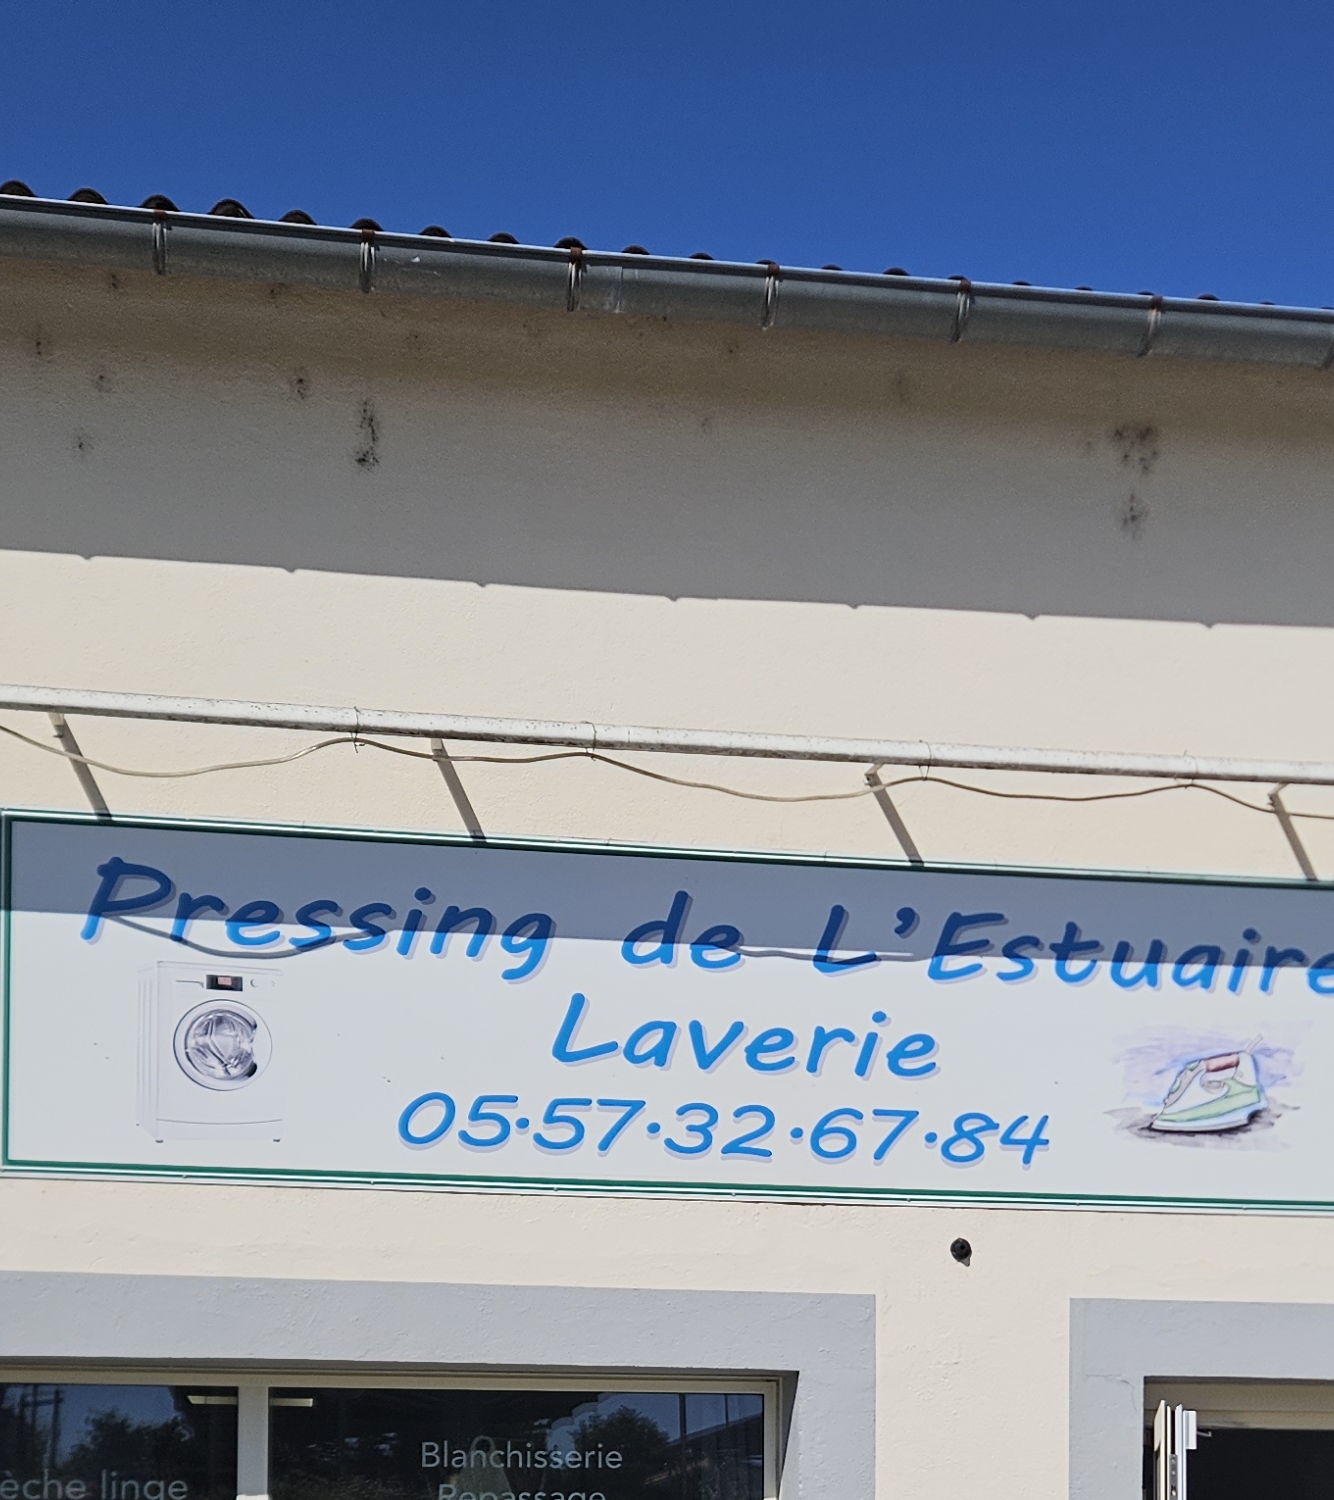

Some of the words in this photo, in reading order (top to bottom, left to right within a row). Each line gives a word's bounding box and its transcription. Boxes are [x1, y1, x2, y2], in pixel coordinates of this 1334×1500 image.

[79, 856, 554, 981] Pressing
[621, 890, 744, 970] de
[551, 992, 940, 1080] Laverie
[420, 1441, 623, 1470] Blanchisserie
